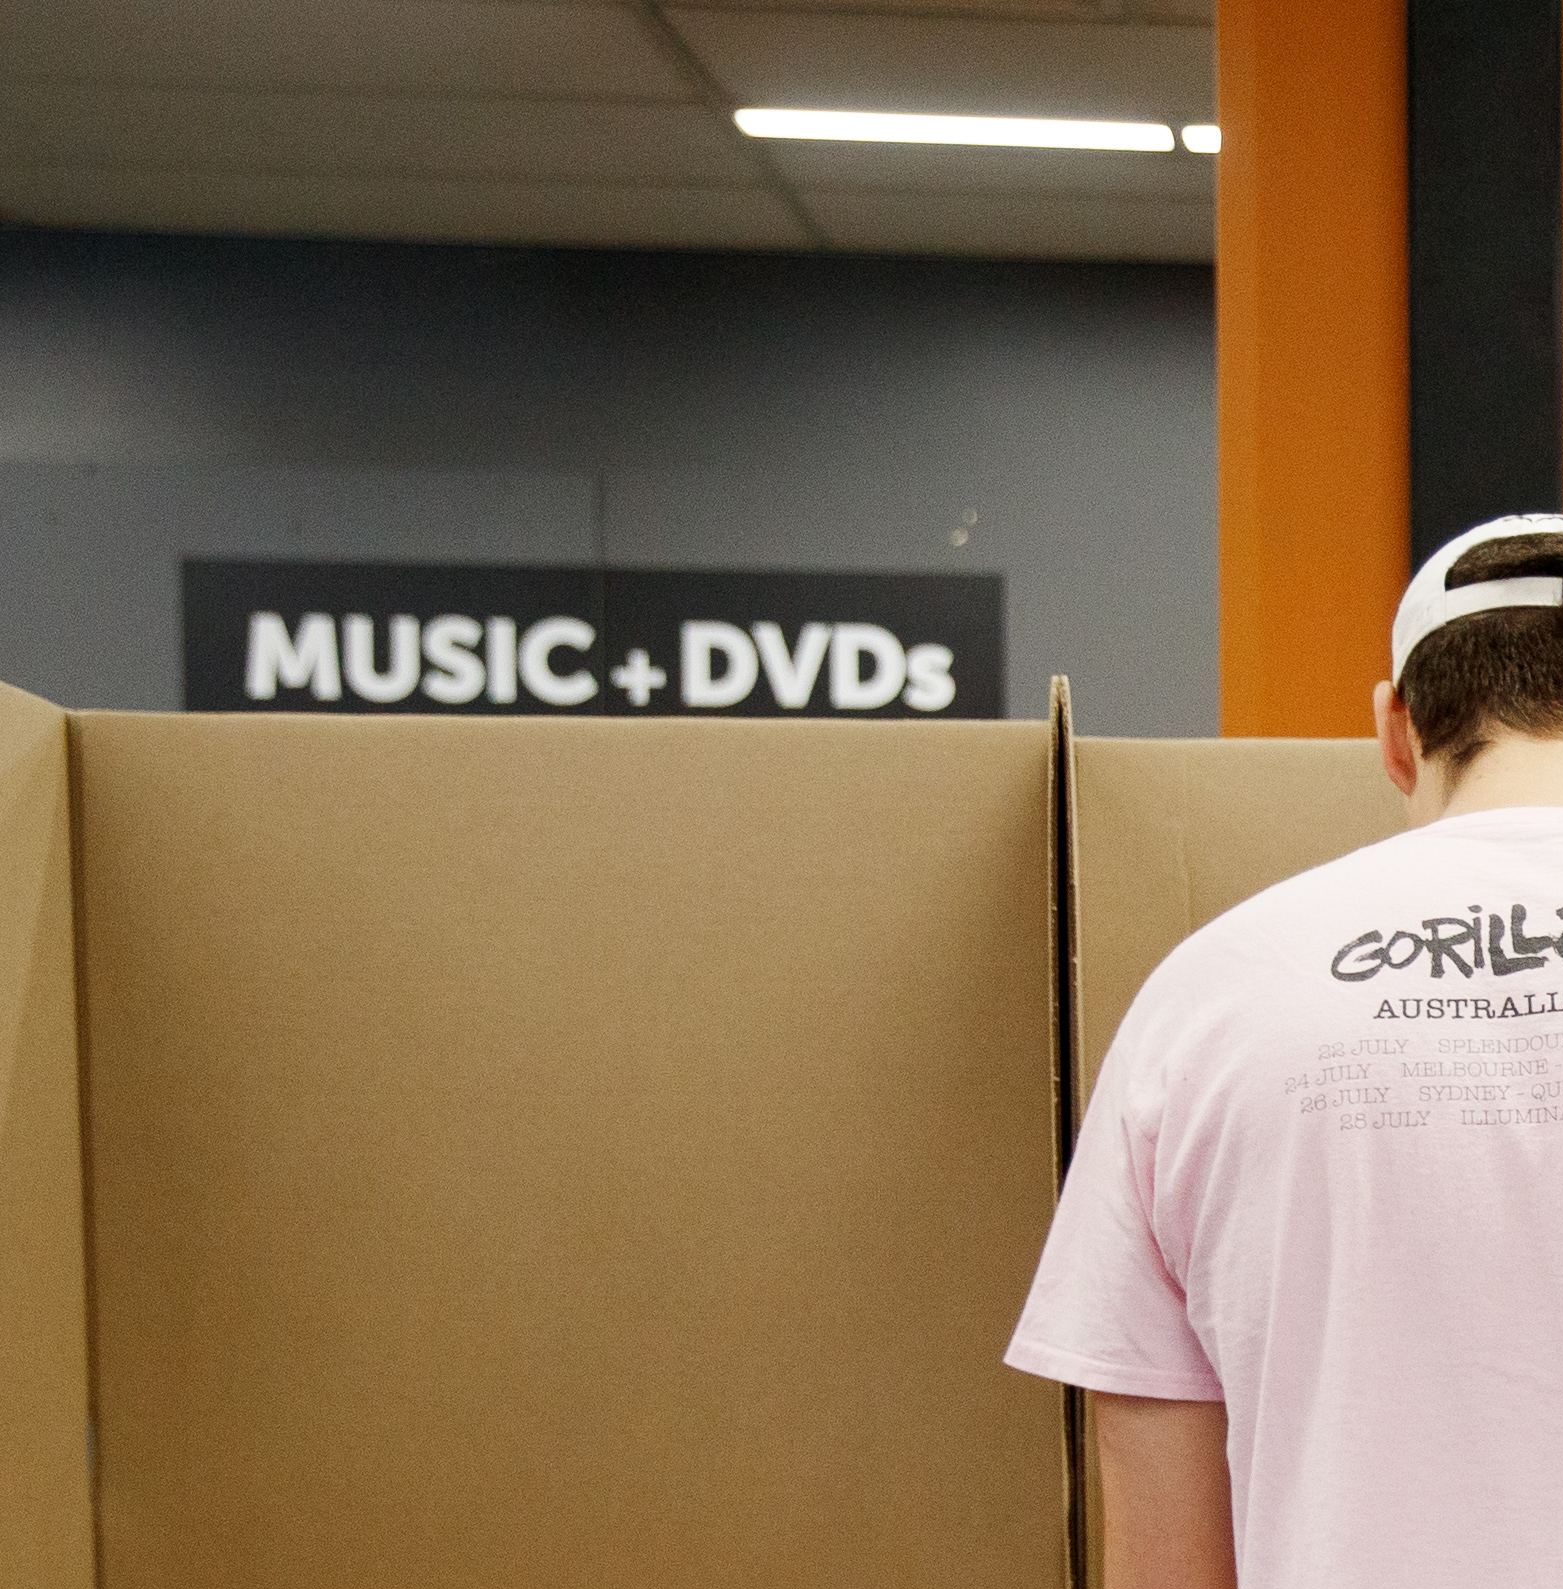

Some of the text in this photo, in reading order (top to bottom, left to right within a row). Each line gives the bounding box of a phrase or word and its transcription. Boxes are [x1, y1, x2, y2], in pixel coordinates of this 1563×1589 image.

[246, 611, 598, 706] MUSIC
[679, 620, 957, 712] DVDs
[1317, 1042, 1346, 1061] 22
[1351, 1038, 1410, 1057] JULY
[1284, 1073, 1309, 1096] 24
[1315, 1063, 1373, 1086] JULY
[1401, 1057, 1549, 1079] MELBOURNE
[1300, 1094, 1328, 1114] 26
[1332, 1086, 1392, 1108] JULY
[1418, 1084, 1511, 1102] SYDNEY
[1340, 1112, 1367, 1132] 28
[1372, 1110, 1432, 1130] JULY
